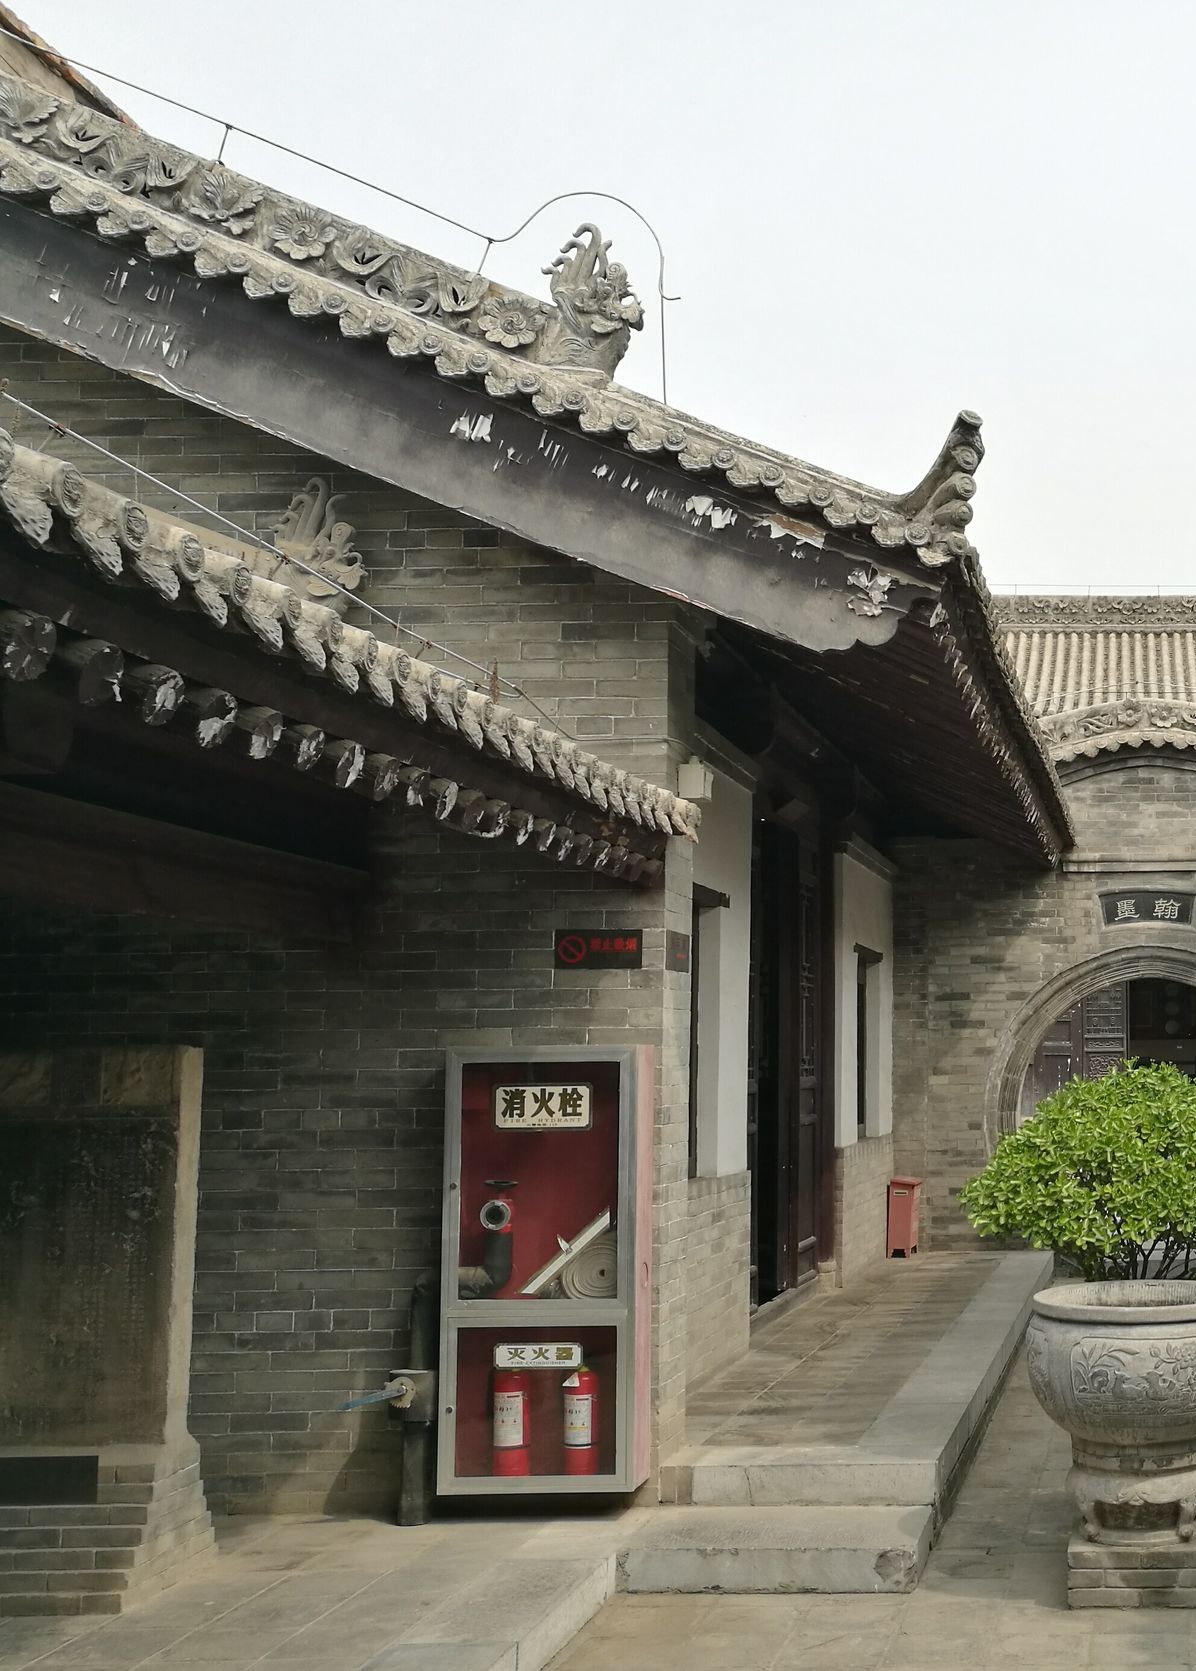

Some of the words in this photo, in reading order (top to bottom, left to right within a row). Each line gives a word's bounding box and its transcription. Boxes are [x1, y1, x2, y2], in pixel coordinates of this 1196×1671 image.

[501, 1088, 584, 1118] 消火栓
[507, 1347, 574, 1360] 灭火器
